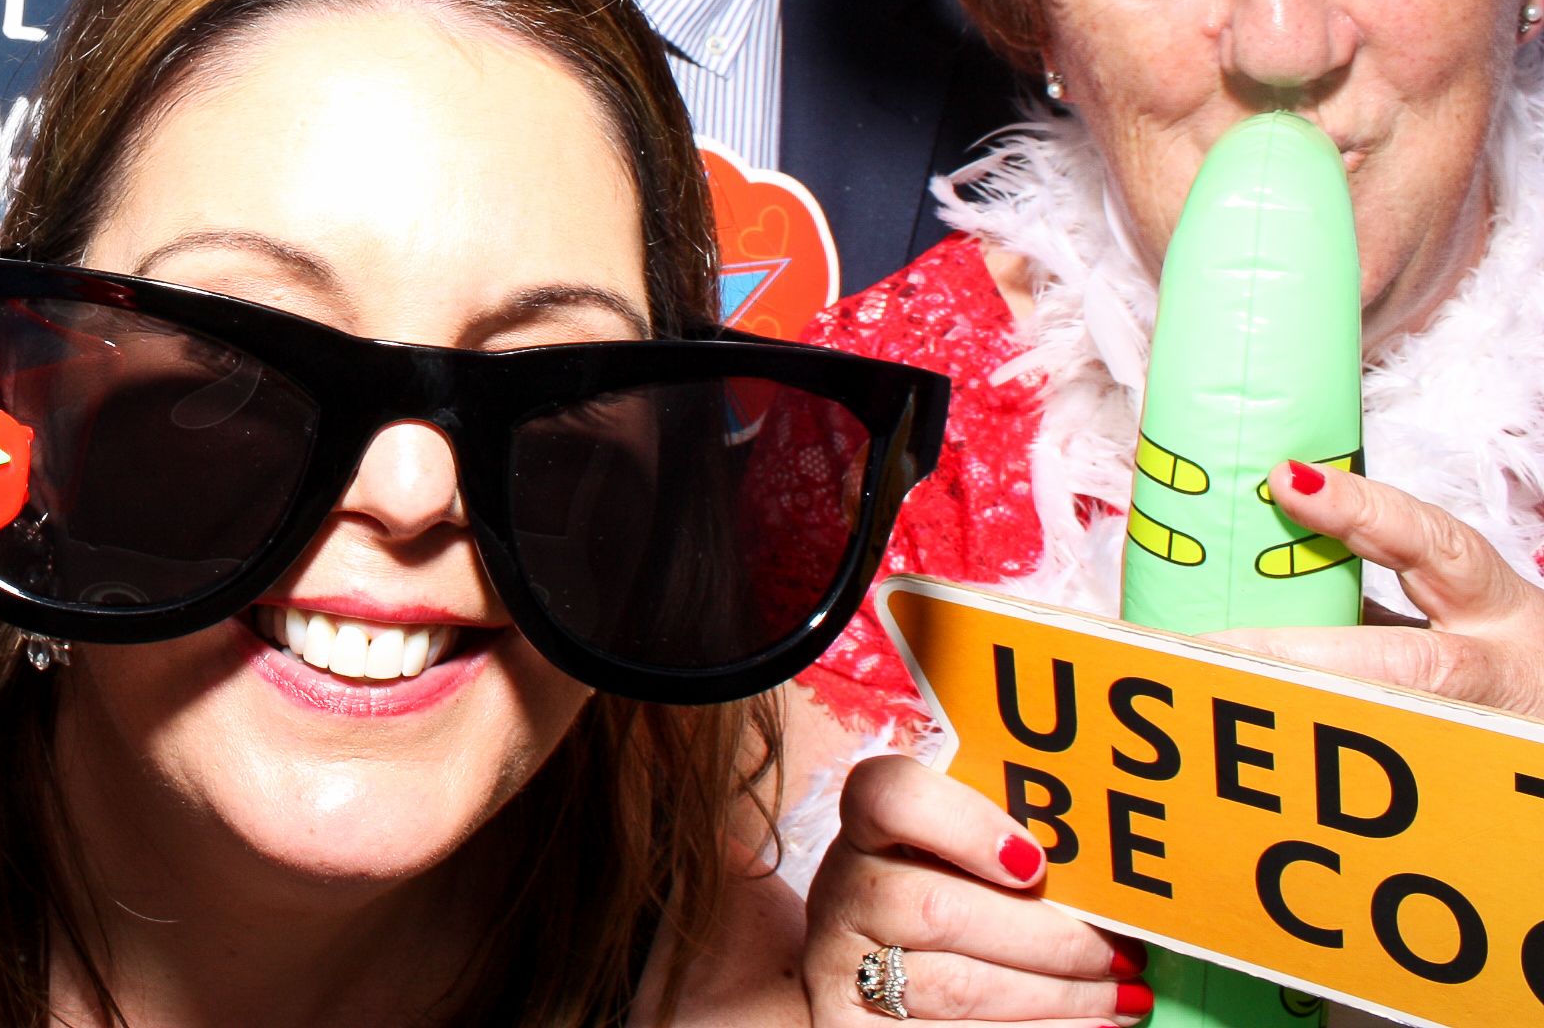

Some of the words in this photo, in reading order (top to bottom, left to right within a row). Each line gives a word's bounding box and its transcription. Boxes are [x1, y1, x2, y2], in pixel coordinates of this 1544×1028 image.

[992, 643, 1420, 840] USED
[1002, 760, 1173, 900] BE
[1254, 839, 1544, 1008] CO
